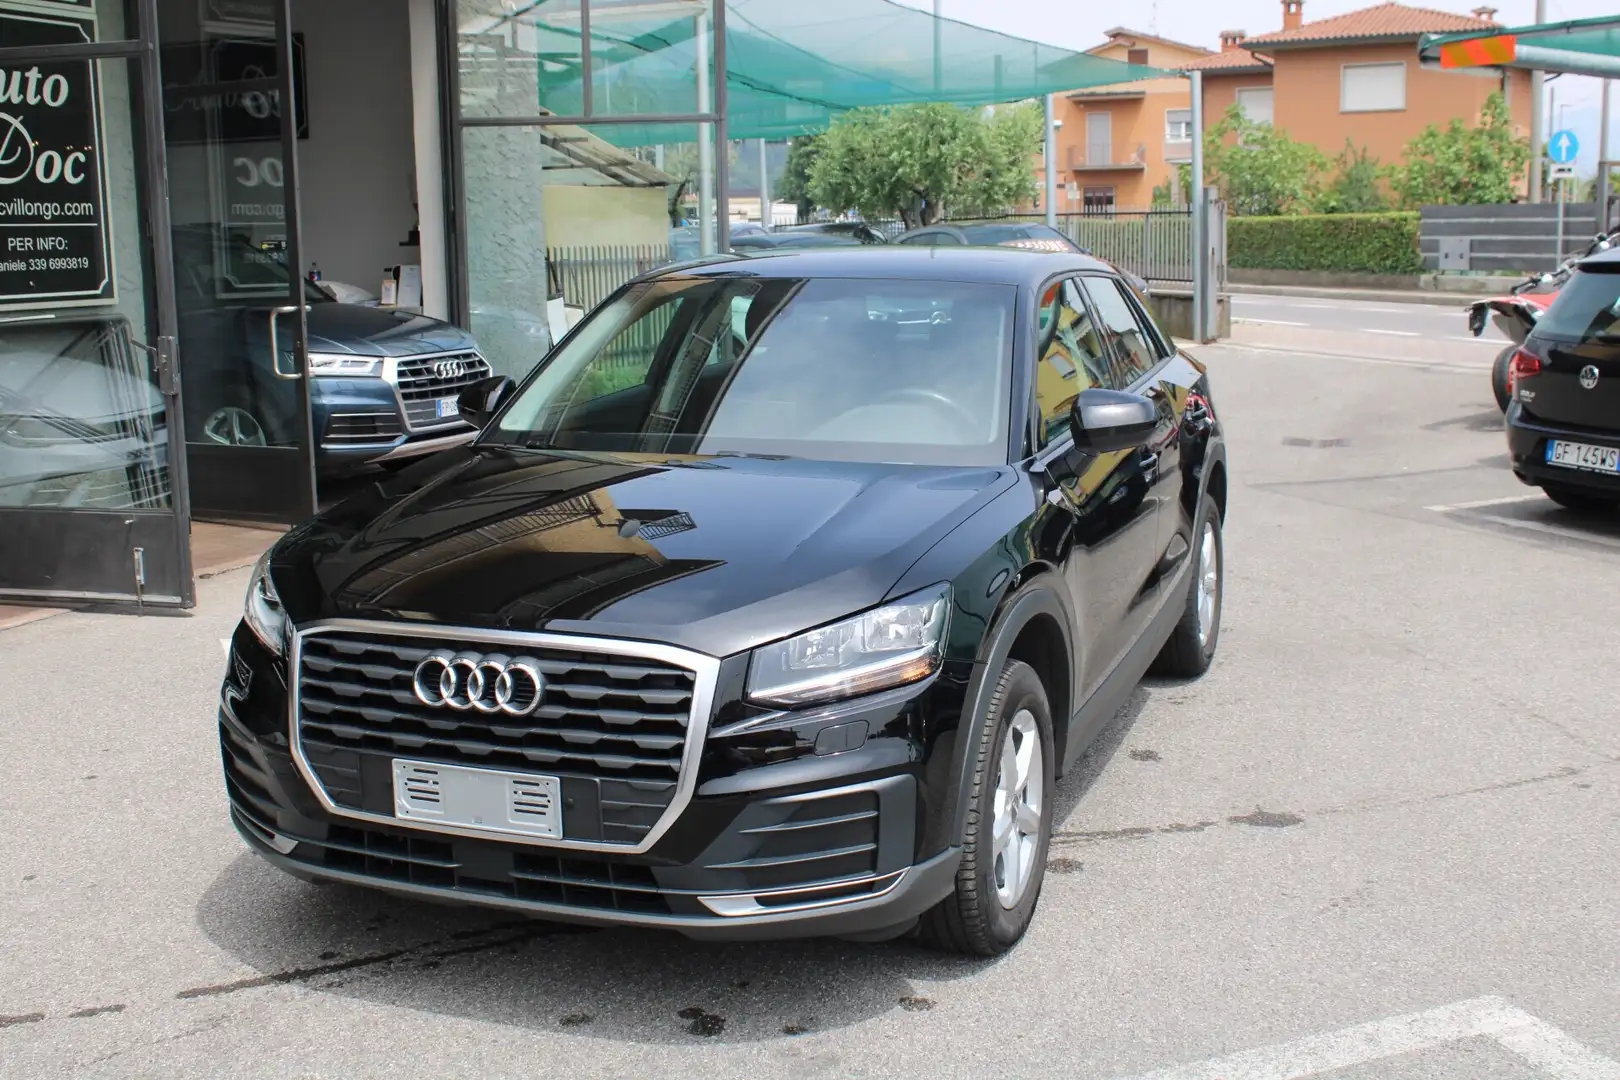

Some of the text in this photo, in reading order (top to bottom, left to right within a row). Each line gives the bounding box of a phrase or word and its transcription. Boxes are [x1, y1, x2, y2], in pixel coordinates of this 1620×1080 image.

[8, 236, 69, 251] PER INFO:
[28, 258, 47, 271] 339
[48, 256, 89, 270] 6993819
[1555, 442, 1617, 468] GF 145WS
